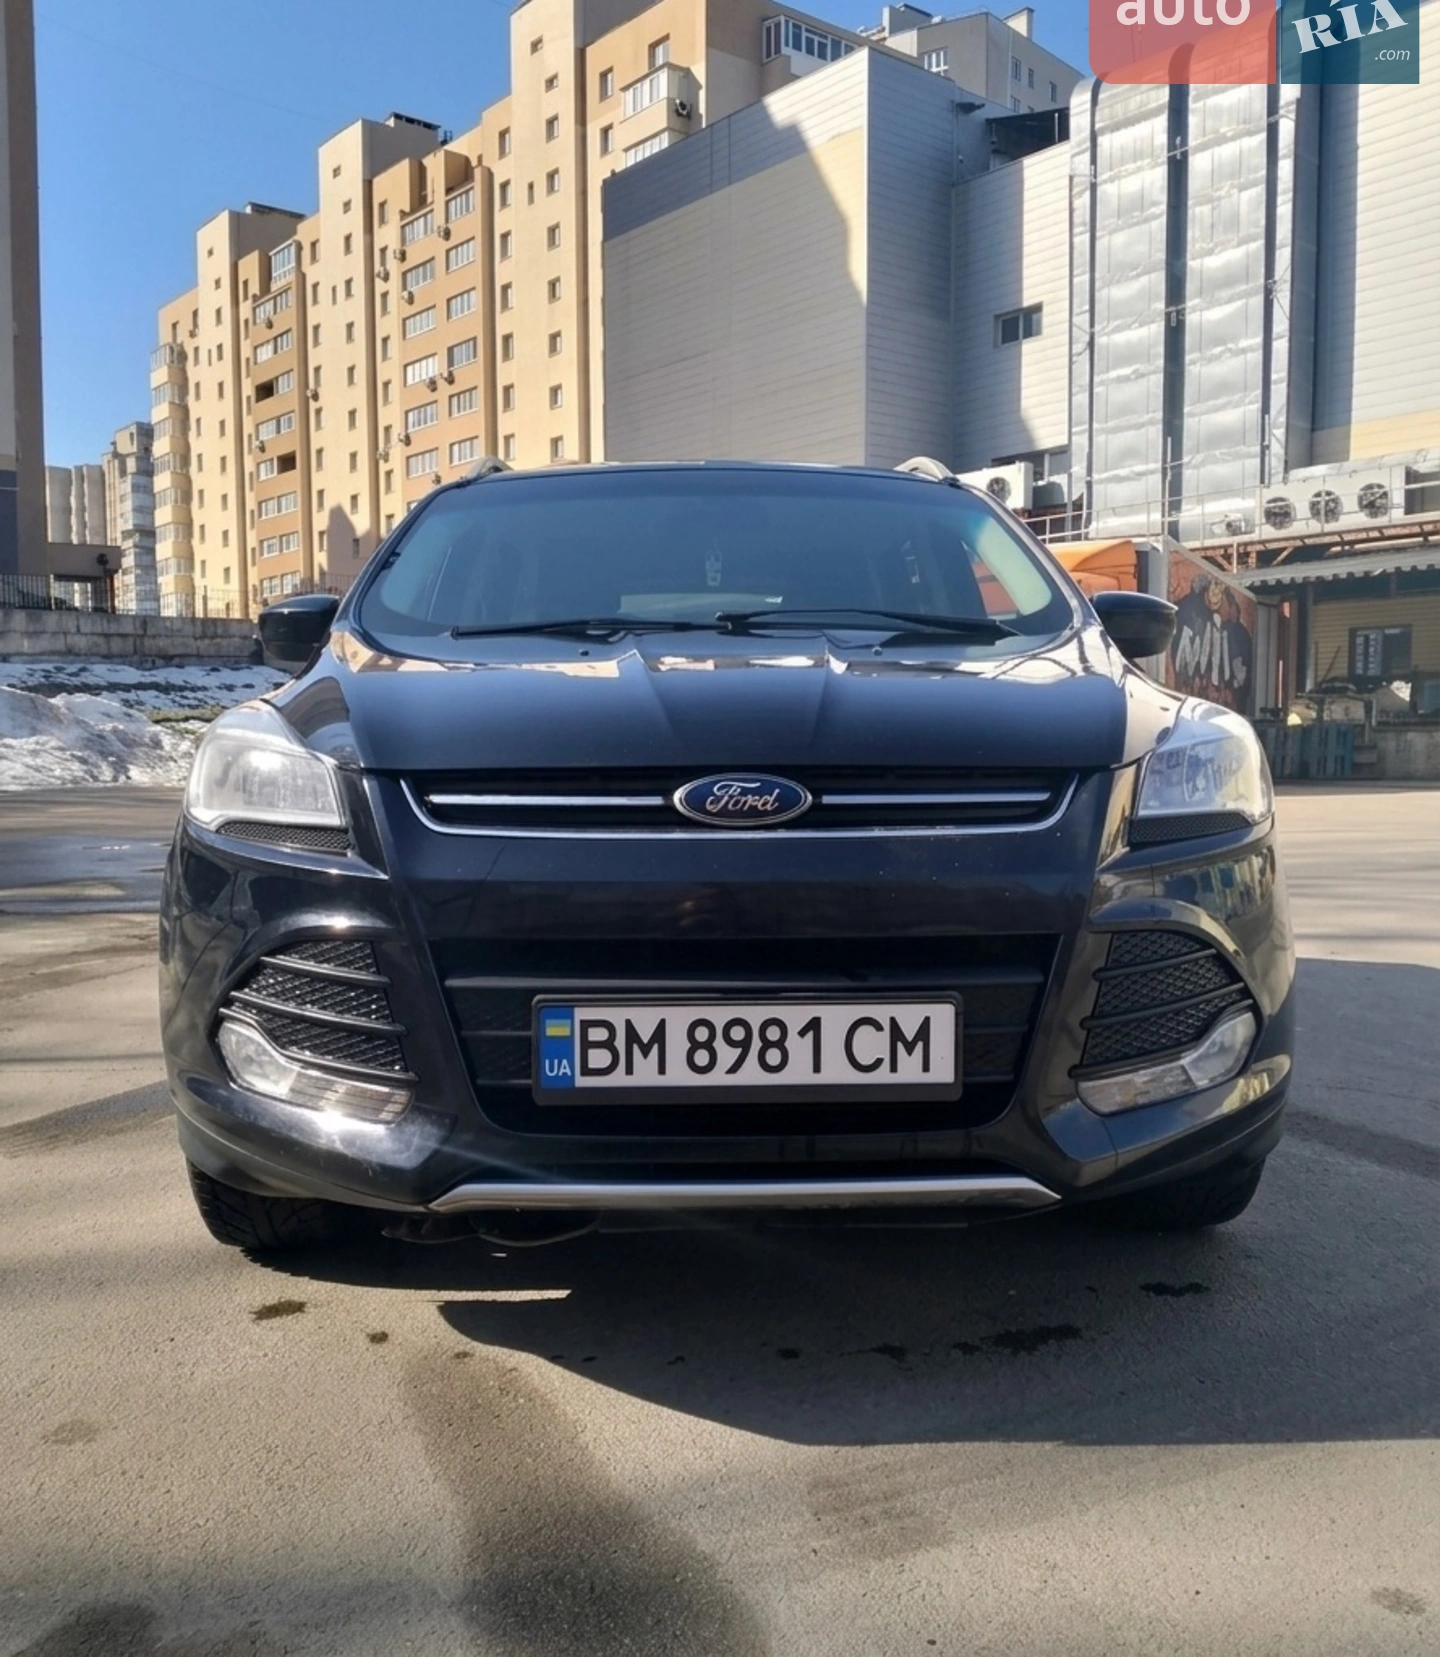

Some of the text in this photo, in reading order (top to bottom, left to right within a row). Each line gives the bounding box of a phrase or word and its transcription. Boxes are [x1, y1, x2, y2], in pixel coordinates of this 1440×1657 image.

[705, 780, 781, 813] Ford
[579, 1016, 931, 1077] BM 8981 CM
[544, 1059, 571, 1077] UA
